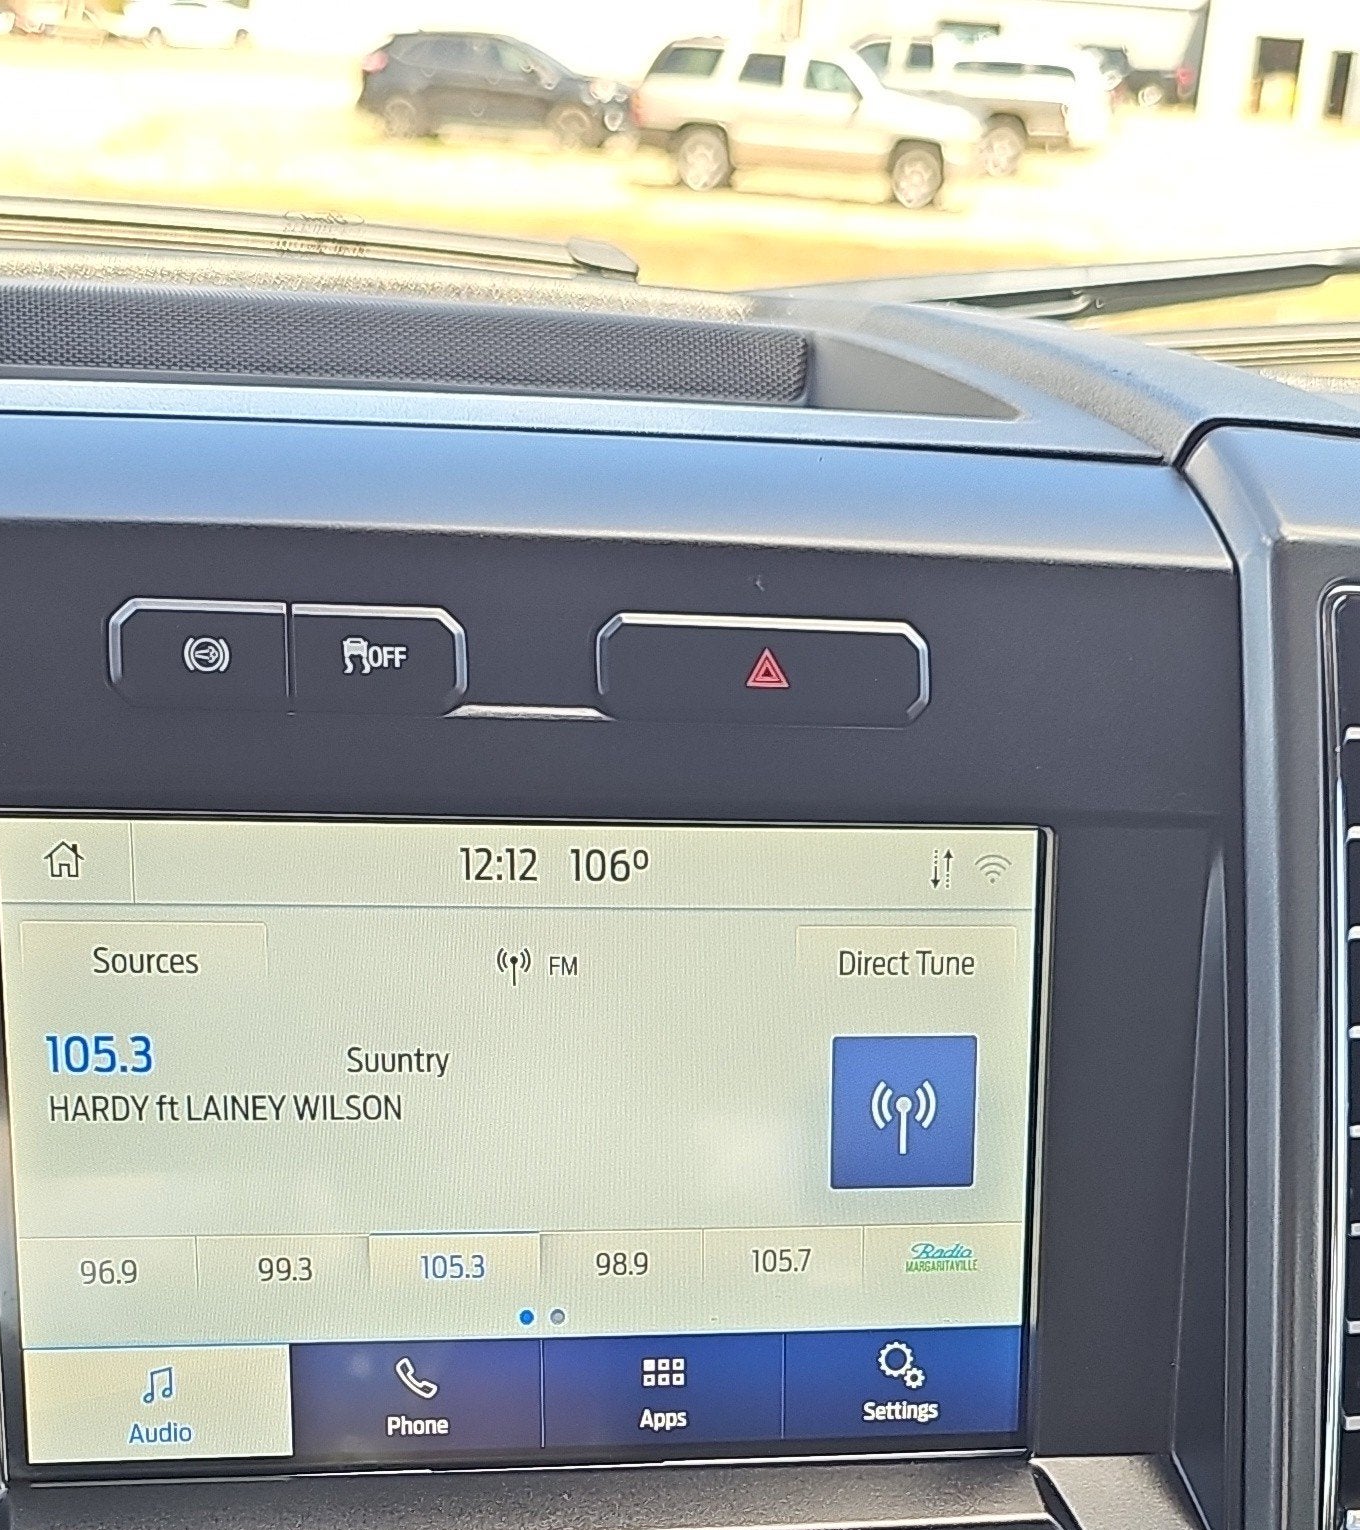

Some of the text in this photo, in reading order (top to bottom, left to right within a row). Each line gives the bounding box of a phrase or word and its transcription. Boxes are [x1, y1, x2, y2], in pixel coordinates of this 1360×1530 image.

[369, 644, 407, 668] OFF
[461, 848, 537, 881] 12:12
[94, 947, 198, 973] Sources
[550, 957, 577, 975] FM
[840, 951, 974, 975] Direct Tune
[46, 1036, 151, 1072] 105.3
[348, 1047, 448, 1077] Suuntry
[51, 1095, 401, 1121] HARDY ft LAINEY WILSON
[753, 1249, 811, 1272] 105.7
[911, 1243, 973, 1259] Radio
[81, 1260, 136, 1284] 96.9
[259, 1258, 312, 1281] 99.3
[421, 1255, 484, 1278] 105.3
[597, 1252, 647, 1275] 98.9
[640, 1409, 686, 1431] Apps
[863, 1401, 938, 1422] Settings
[129, 1422, 191, 1443] Audio
[388, 1416, 449, 1437] Phone
